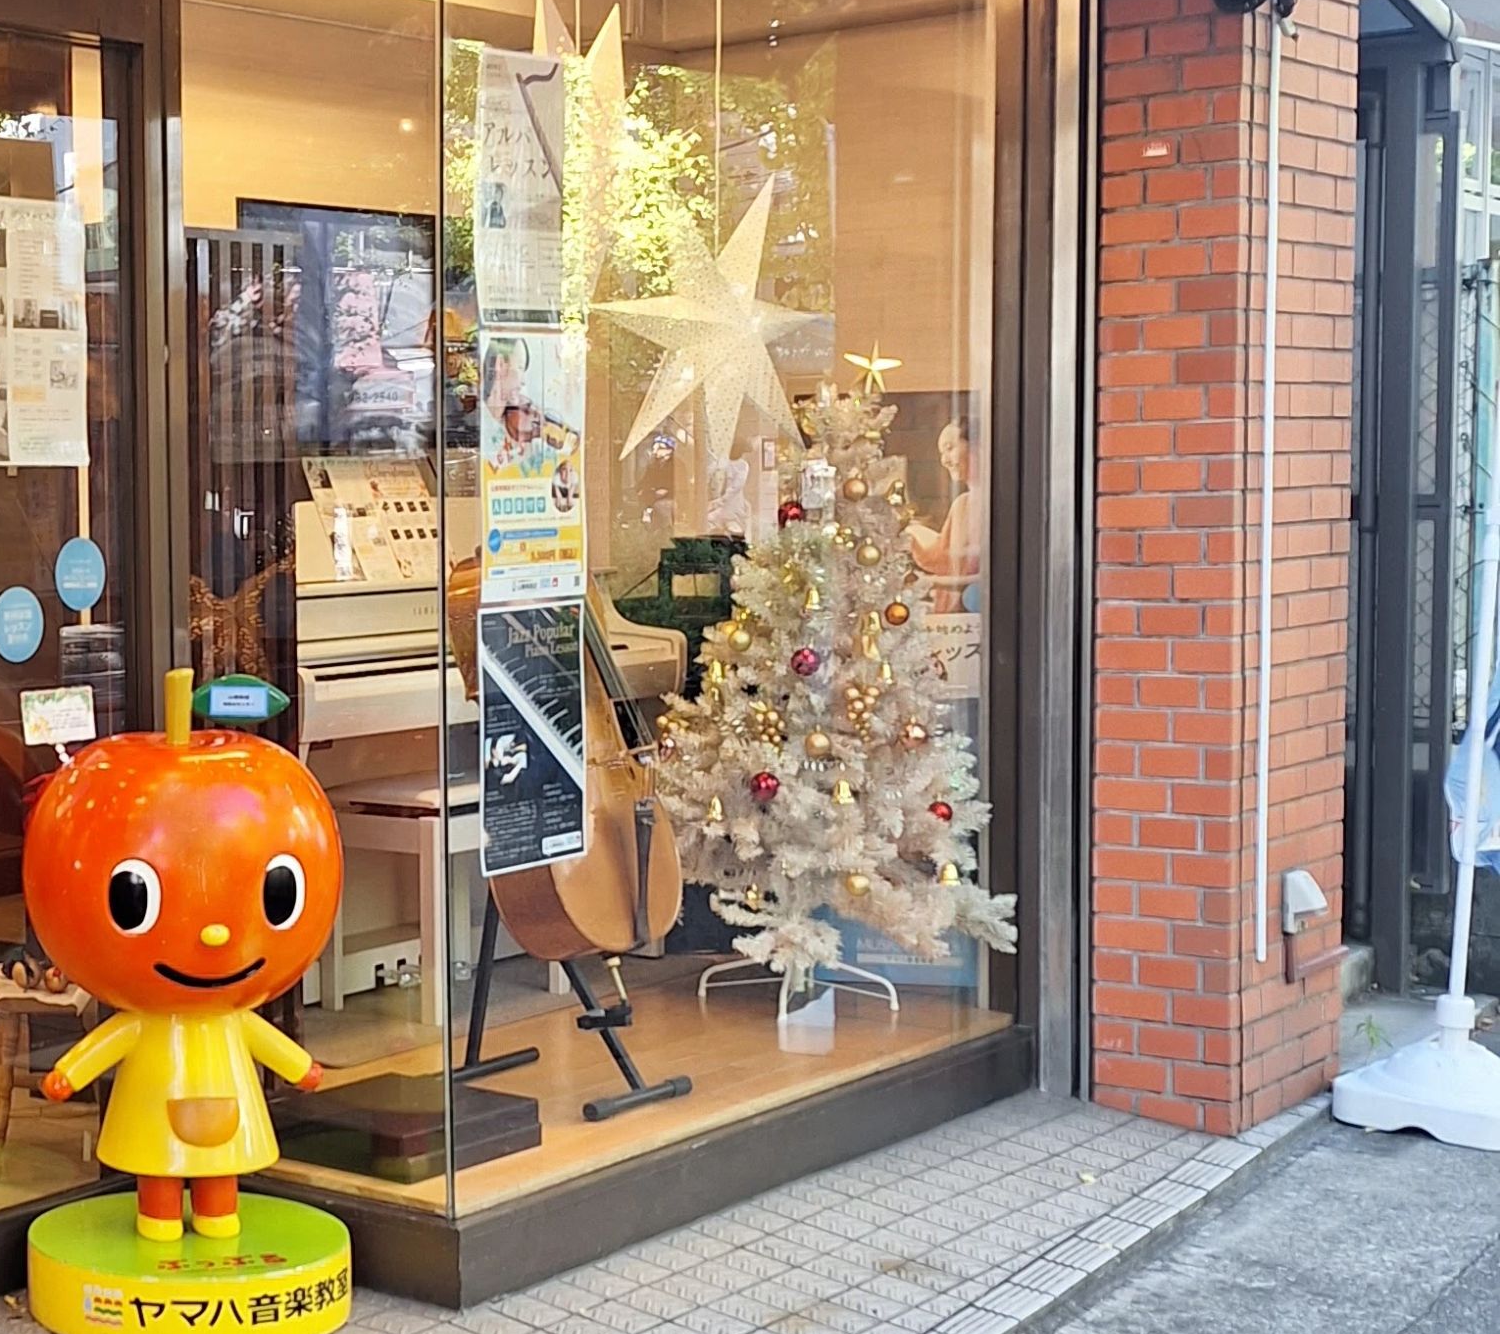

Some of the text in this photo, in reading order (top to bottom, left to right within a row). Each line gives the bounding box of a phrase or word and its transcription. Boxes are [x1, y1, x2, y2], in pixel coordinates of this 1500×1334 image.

[129, 1267, 349, 1329] ヤマハ音楽教室
